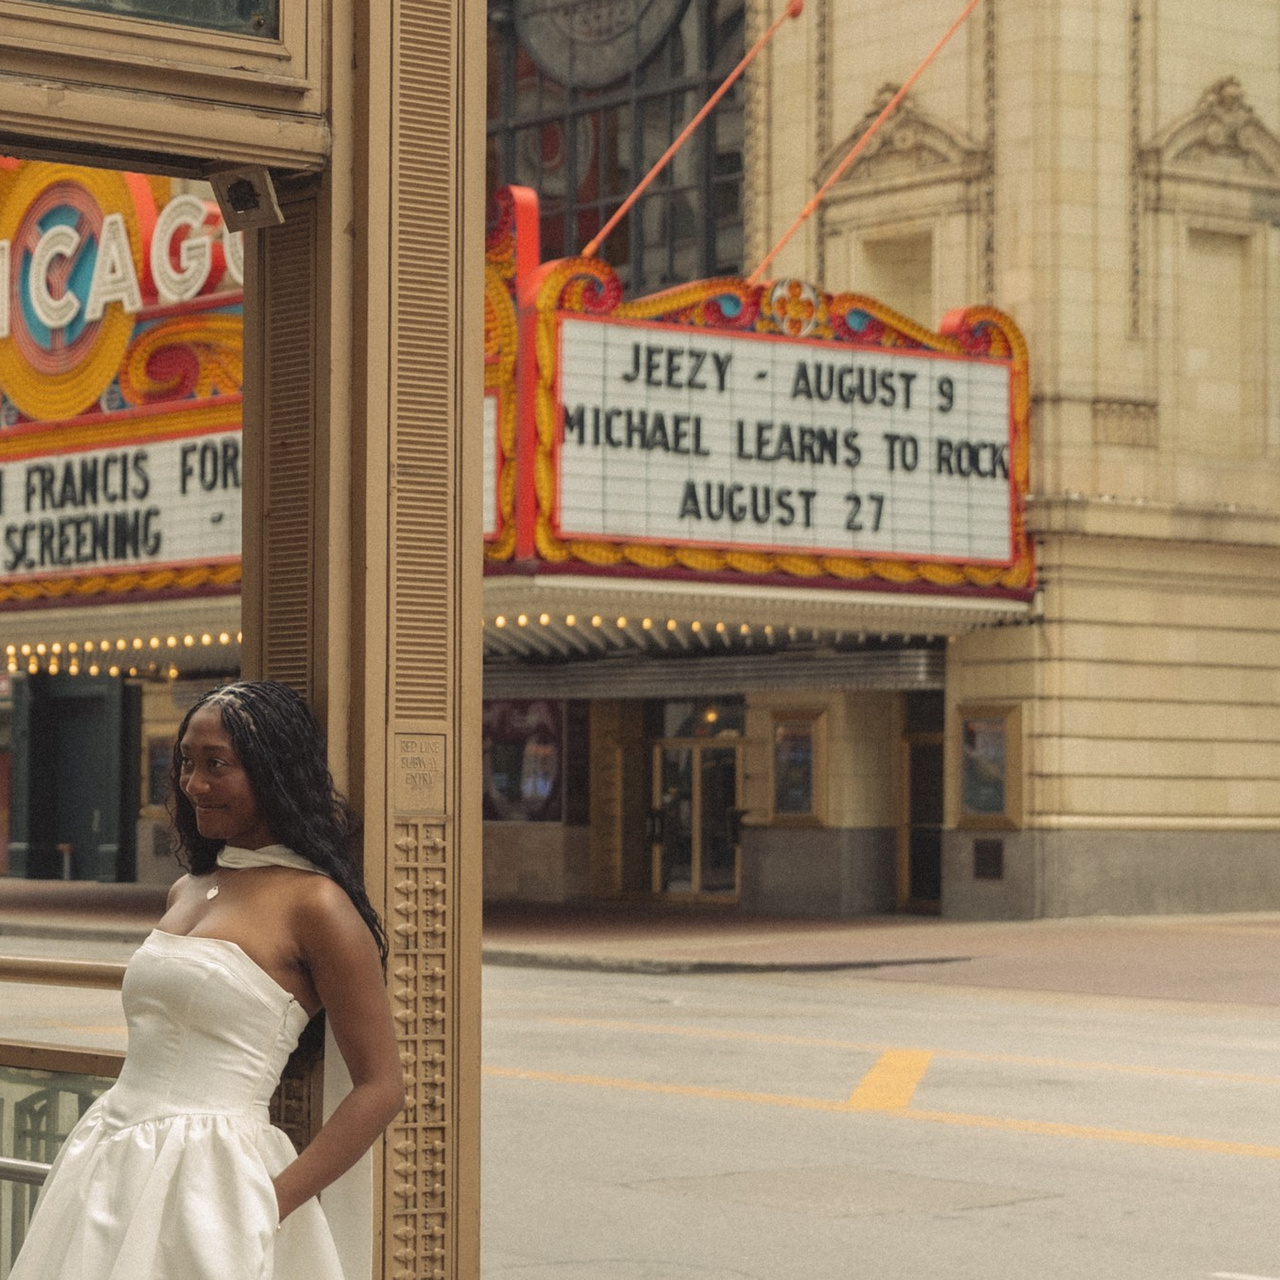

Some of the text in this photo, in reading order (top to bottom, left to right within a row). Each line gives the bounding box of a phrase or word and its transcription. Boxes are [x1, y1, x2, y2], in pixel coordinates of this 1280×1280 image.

[622, 343, 733, 392] JEEZY
[792, 360, 917, 410] AUGUST
[937, 375, 954, 413] 9
[560, 404, 1010, 480] MICHAEL LEARNS TO ROCK
[25, 449, 150, 513] FRANCIS
[678, 478, 885, 532] AUGUST 27
[4, 505, 162, 571] SCREENING
[400, 740, 440, 754] RED LINE
